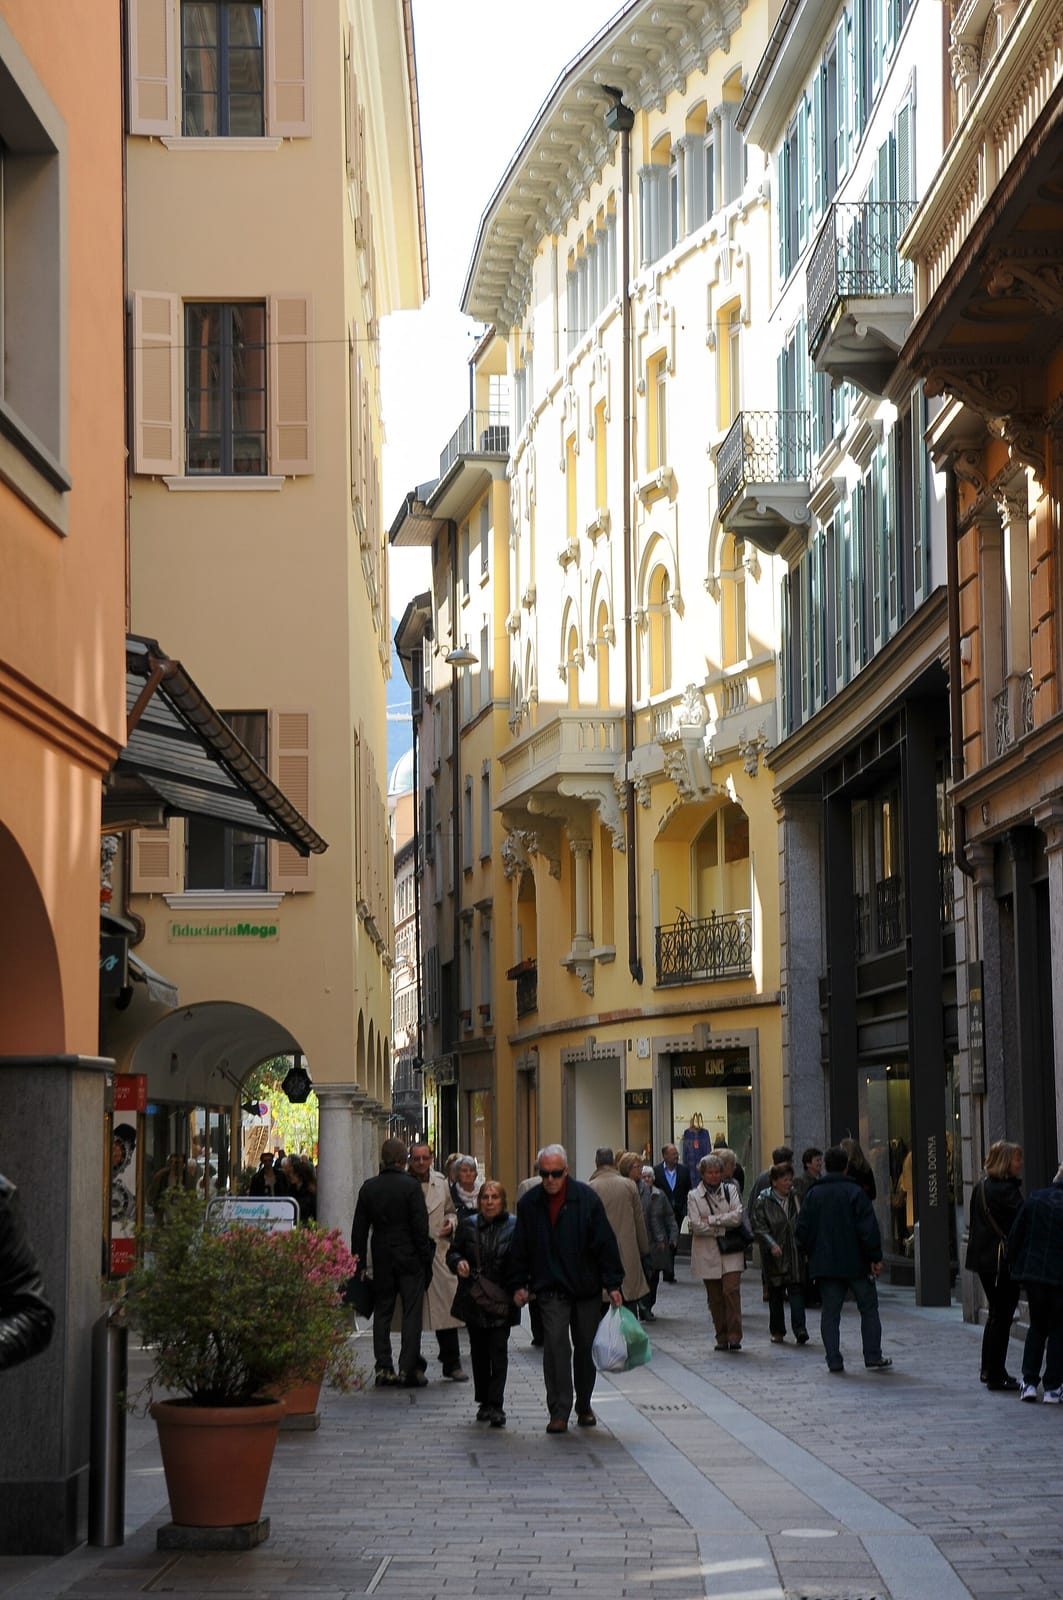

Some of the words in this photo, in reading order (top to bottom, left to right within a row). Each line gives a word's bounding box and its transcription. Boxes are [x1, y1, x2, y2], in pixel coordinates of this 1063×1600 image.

[705, 1059, 724, 1075] KING
[928, 1136, 936, 1170] DONNA
[928, 1173, 937, 1206] NASSA
